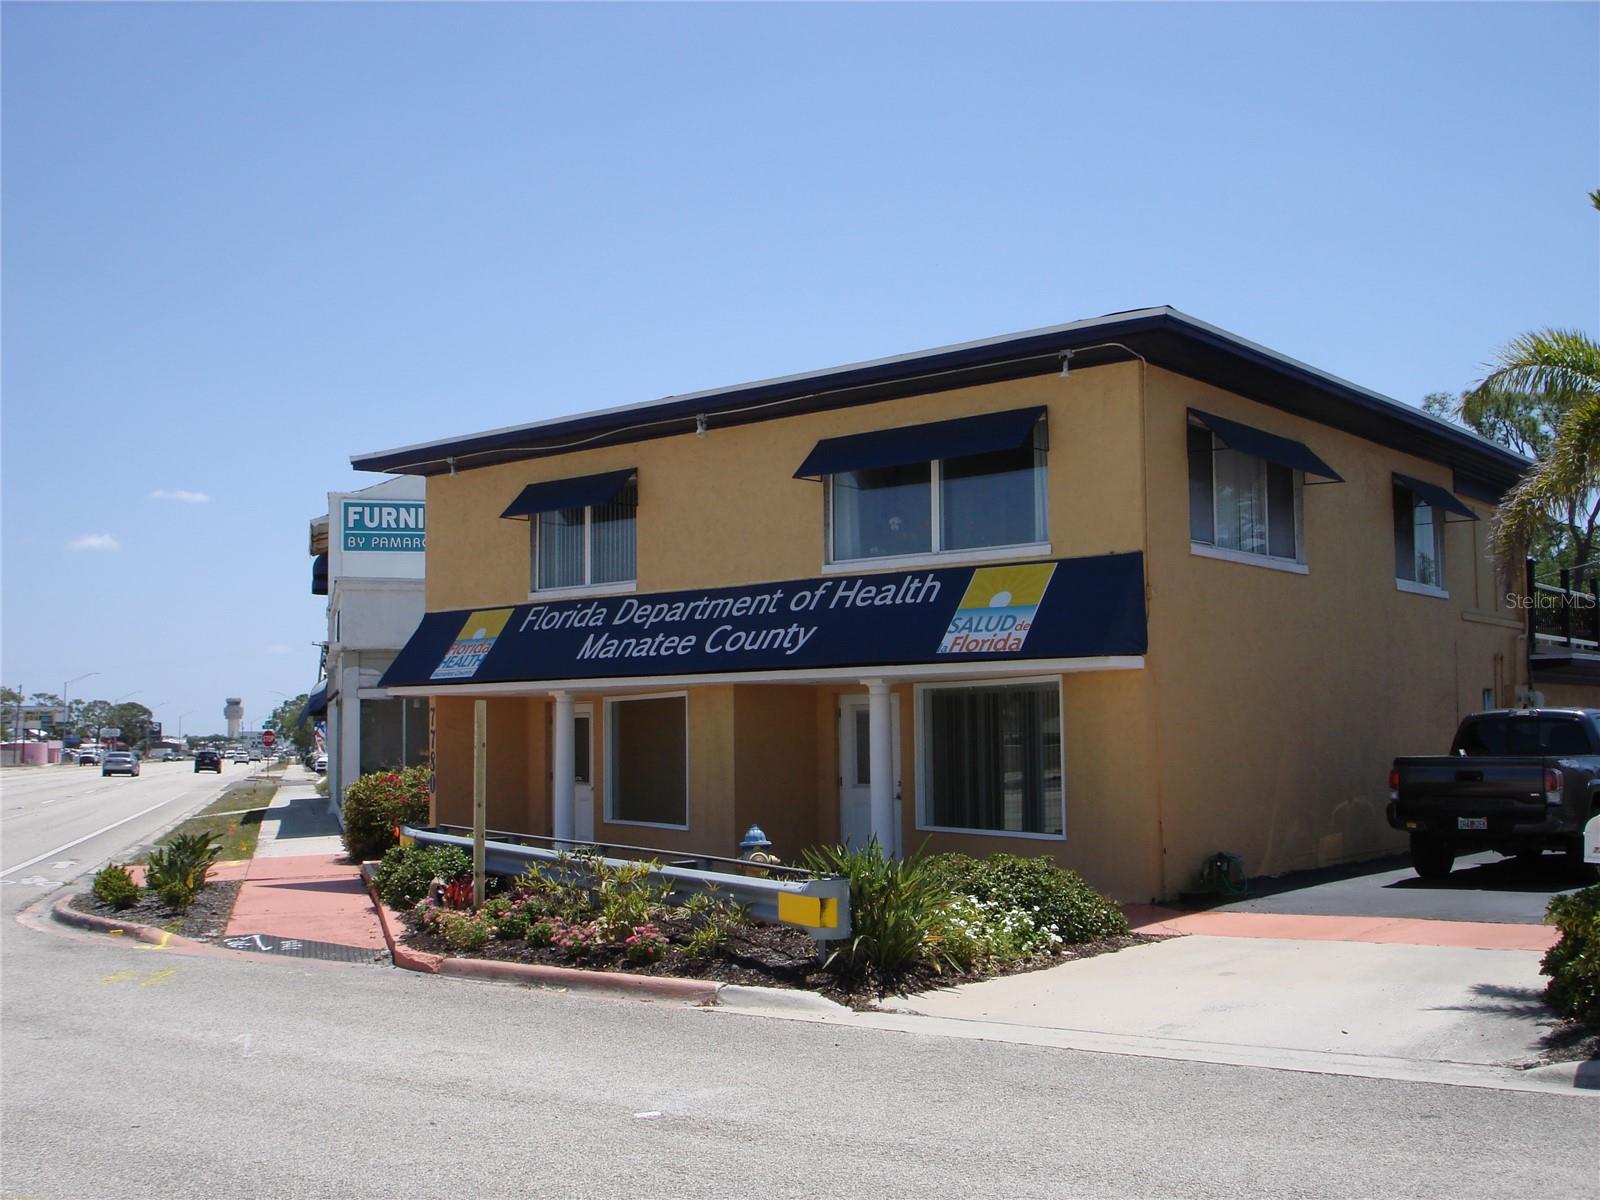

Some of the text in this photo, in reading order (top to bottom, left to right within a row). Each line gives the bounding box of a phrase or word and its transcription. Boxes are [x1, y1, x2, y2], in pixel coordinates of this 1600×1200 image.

[348, 506, 424, 529] FURNI
[348, 536, 366, 548] BY
[519, 574, 942, 633] Florida Department of Health
[947, 614, 1031, 634] SALUD de
[576, 623, 819, 660] Manatee County
[948, 632, 1022, 655] Florida
